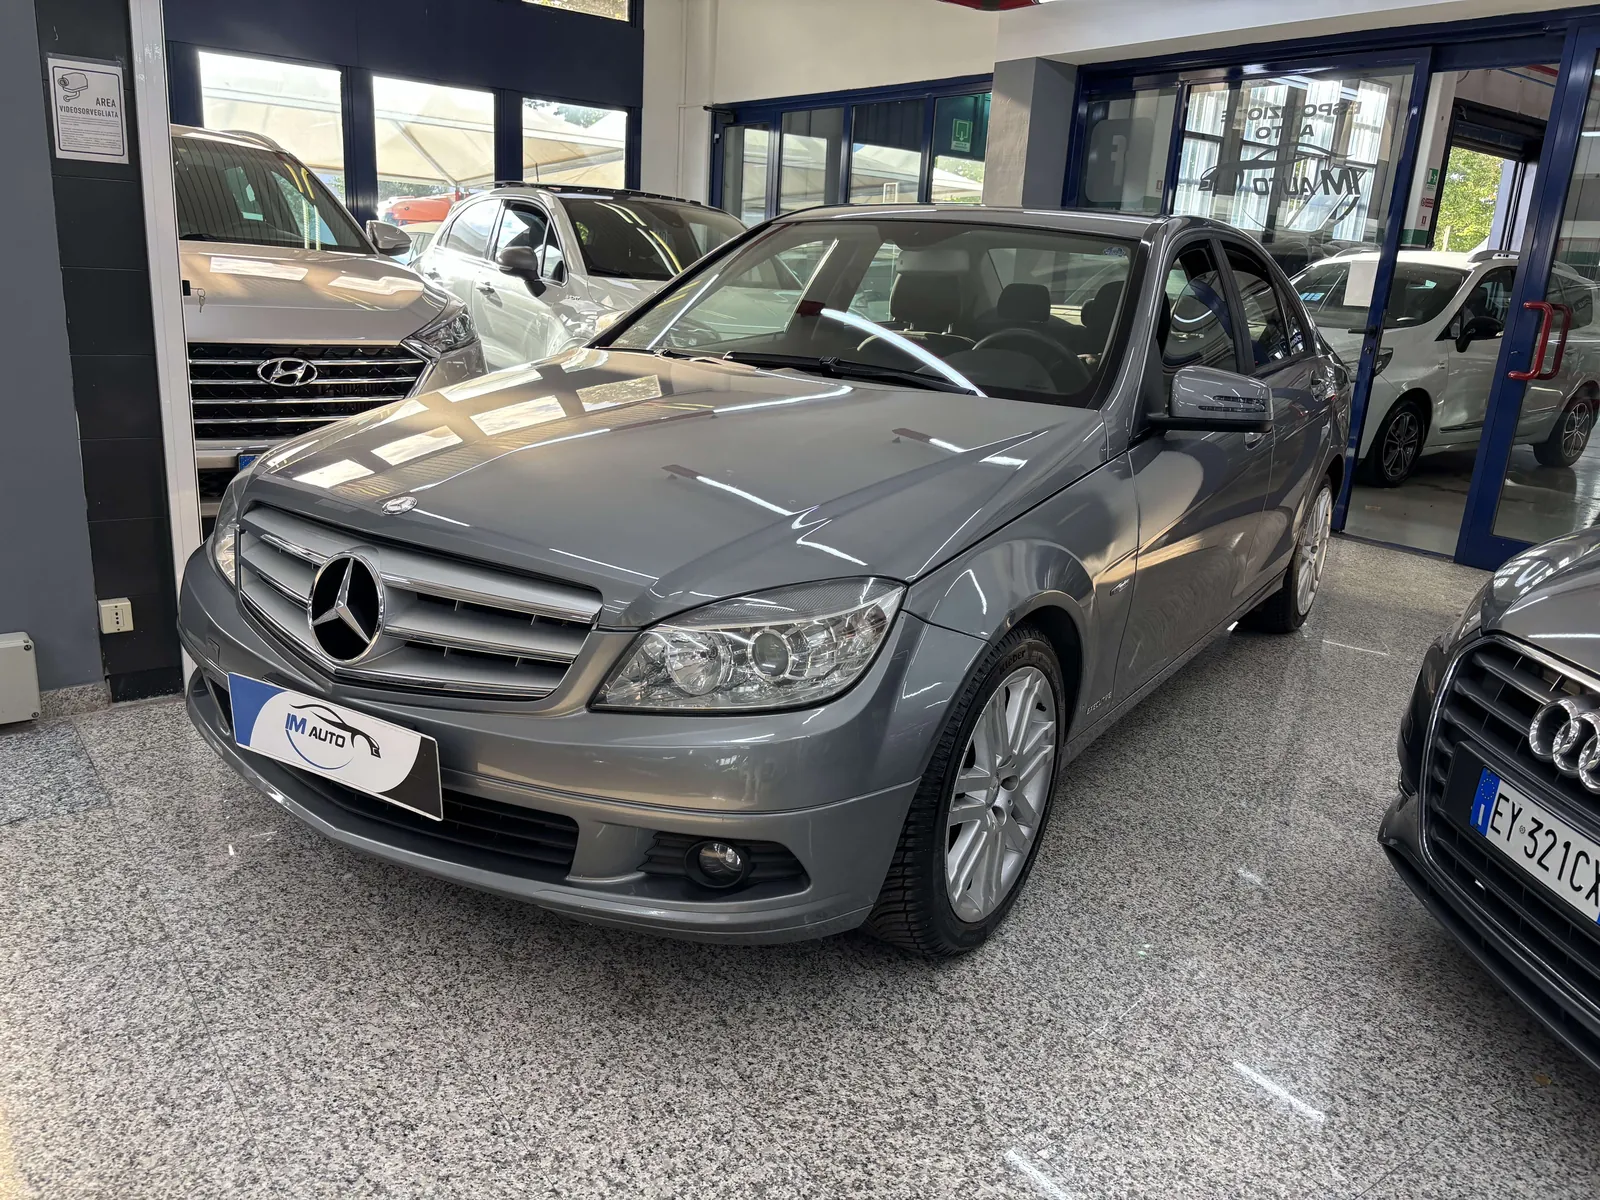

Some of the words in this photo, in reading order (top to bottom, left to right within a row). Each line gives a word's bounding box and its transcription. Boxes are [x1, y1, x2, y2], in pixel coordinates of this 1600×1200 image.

[95, 97, 117, 108] AREA
[58, 104, 119, 119] VIDEOSORVEGLIATA
[284, 712, 308, 735] IM
[308, 726, 346, 748] AUTO
